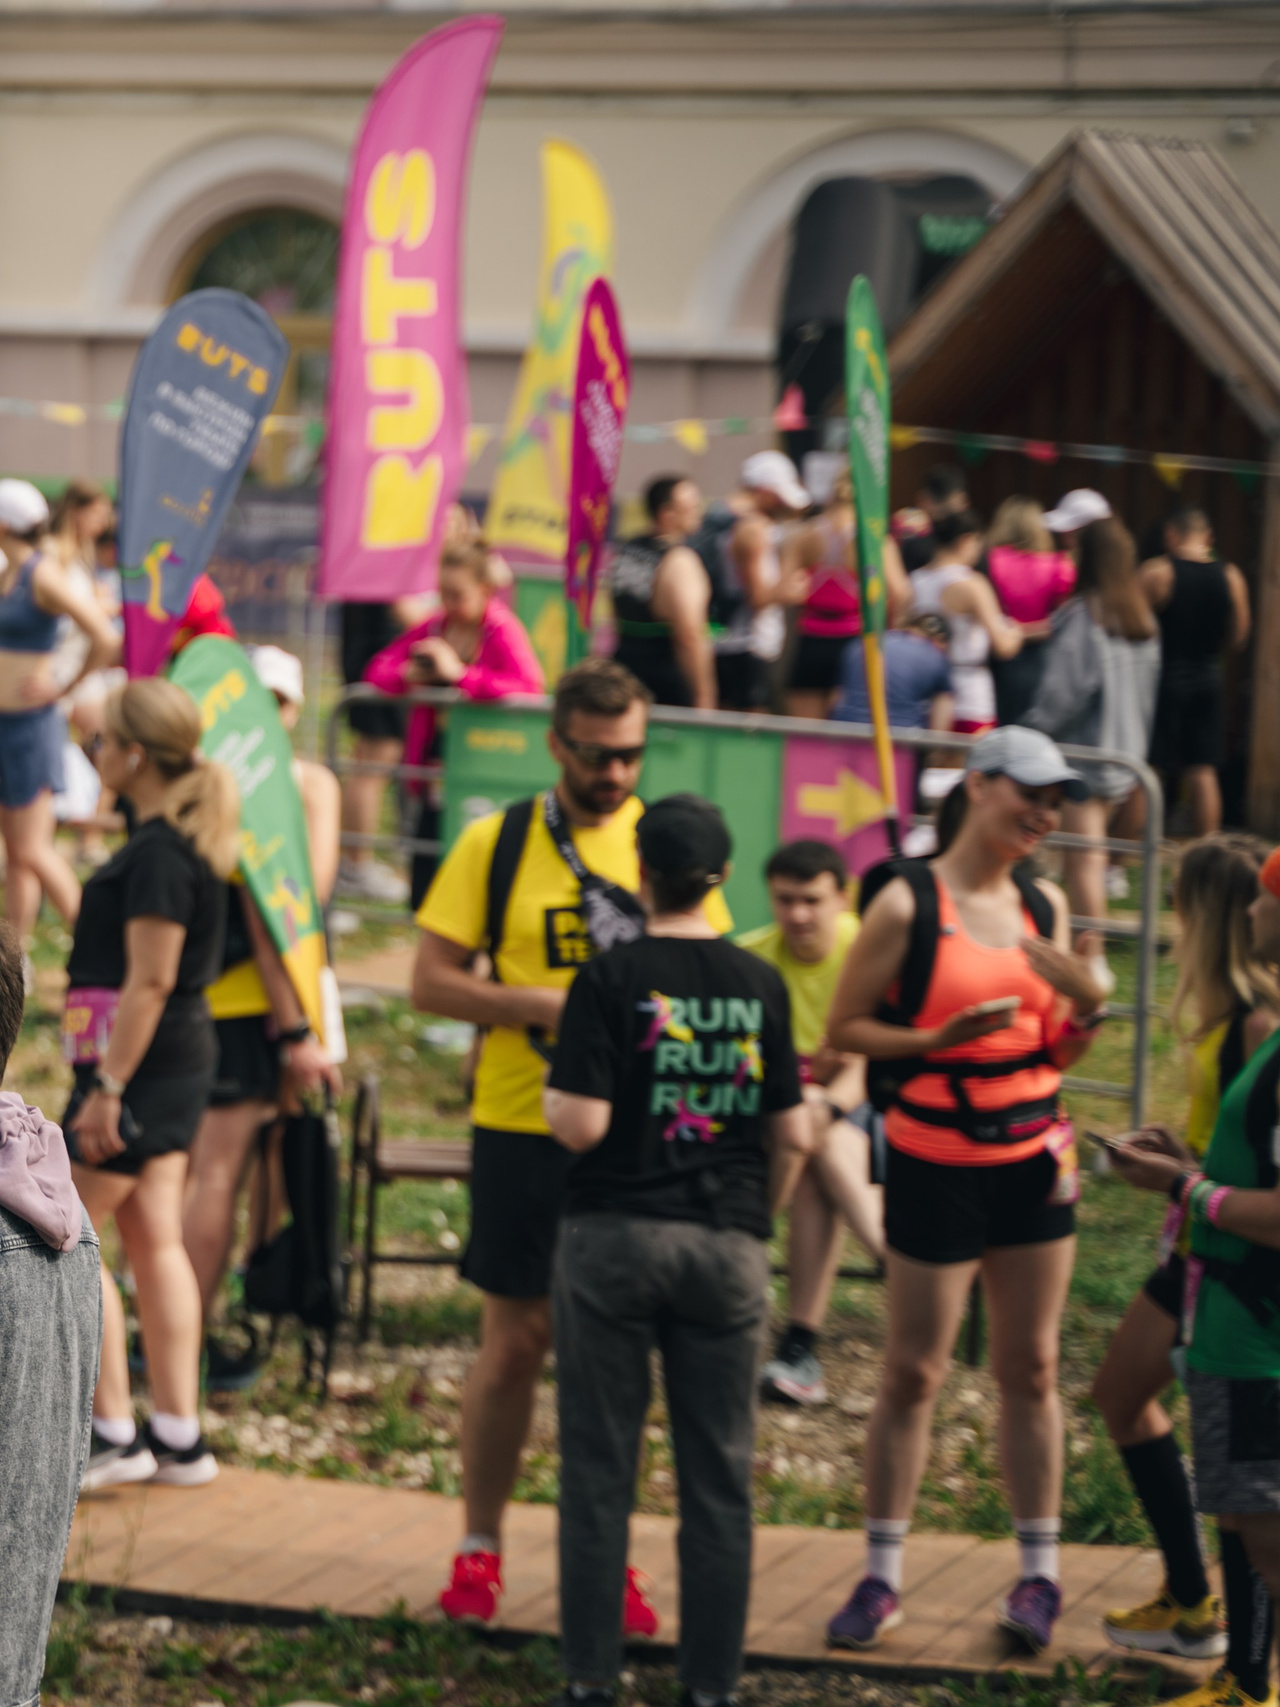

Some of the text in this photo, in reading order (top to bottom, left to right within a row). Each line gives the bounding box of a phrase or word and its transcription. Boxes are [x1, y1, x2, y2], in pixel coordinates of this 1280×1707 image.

[177, 323, 269, 394] RUTS
[363, 148, 444, 548] RUTS
[661, 997, 763, 1032] RUN
[654, 1040, 763, 1075] RUN
[650, 1081, 762, 1116] RUN
